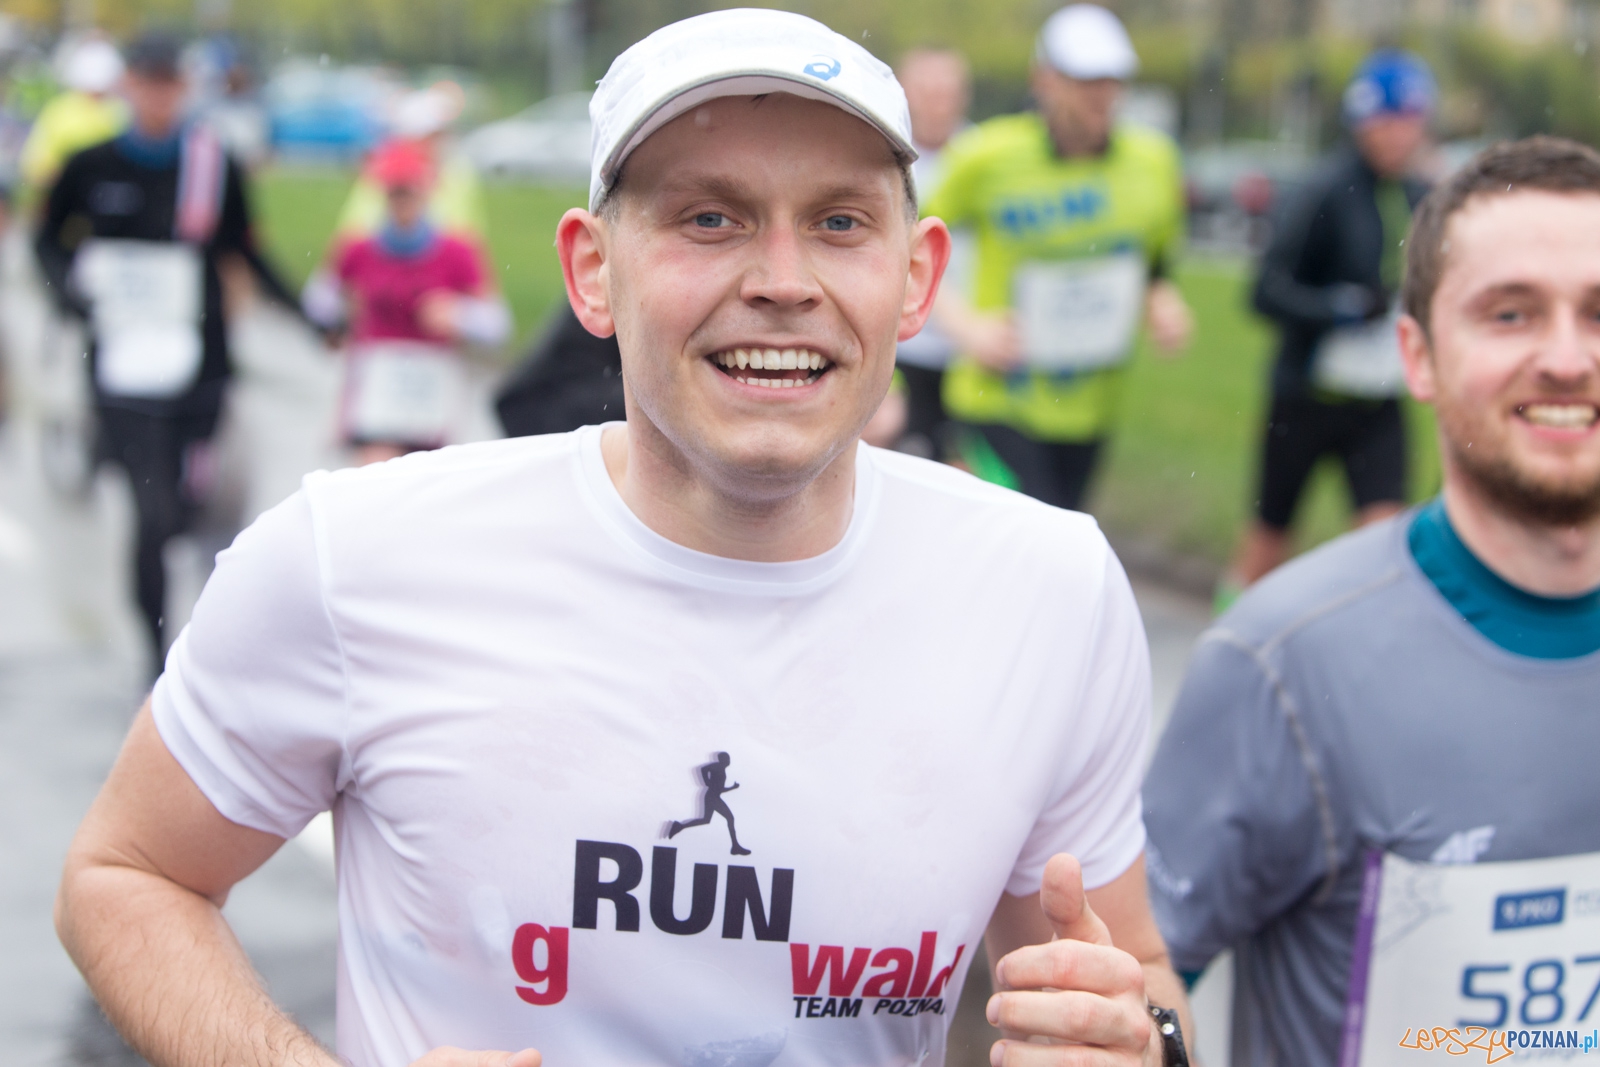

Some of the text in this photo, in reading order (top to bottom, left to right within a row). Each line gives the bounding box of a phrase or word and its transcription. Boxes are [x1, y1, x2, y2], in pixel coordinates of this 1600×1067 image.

[572, 839, 794, 942] RUN
[793, 996, 948, 1018] TEAM POZNA
